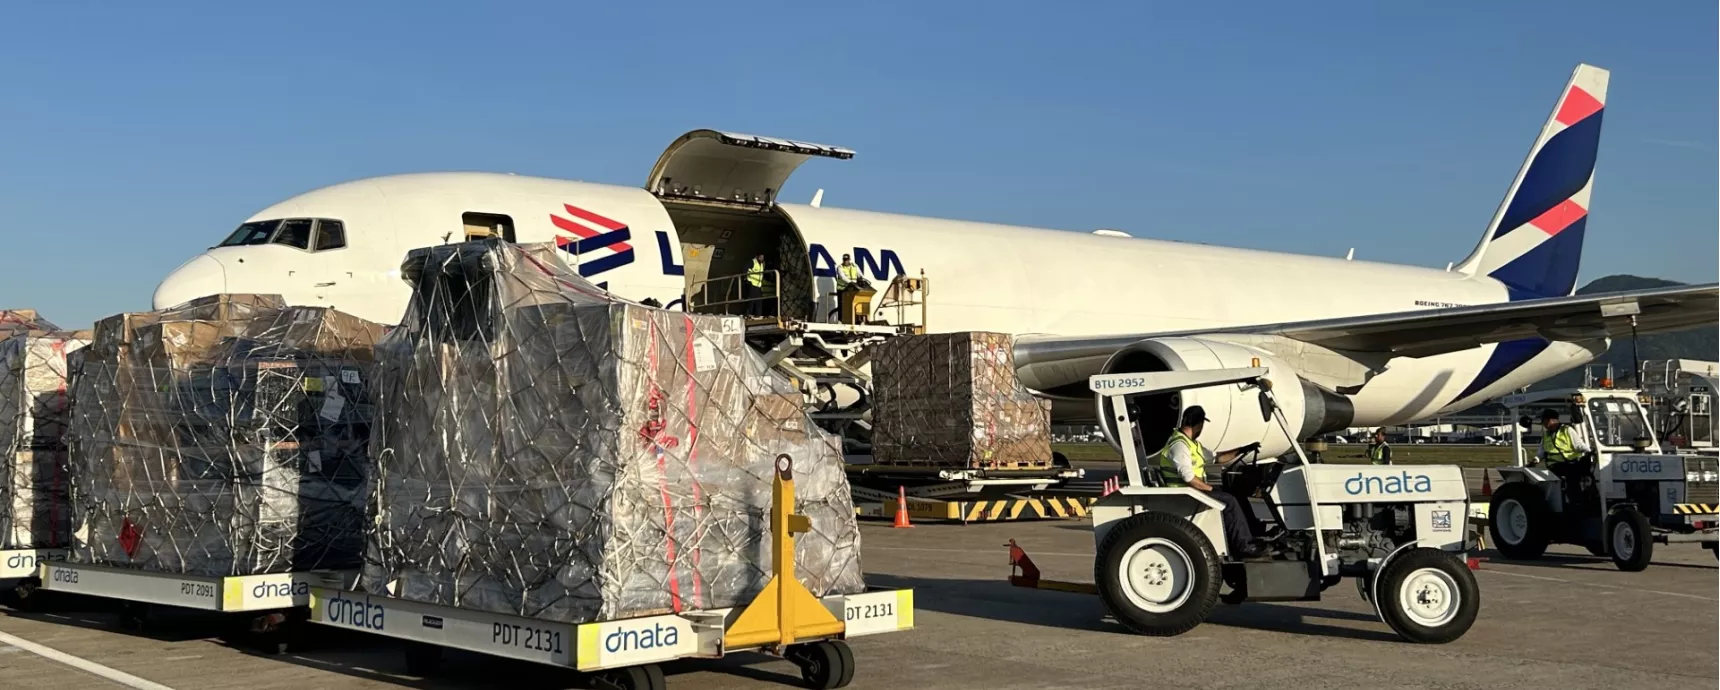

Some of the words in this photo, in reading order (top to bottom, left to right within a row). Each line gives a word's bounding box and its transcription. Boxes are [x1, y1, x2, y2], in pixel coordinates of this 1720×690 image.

[1095, 380, 1115, 389] BTU
[1118, 378, 1145, 388] 2952
[1621, 456, 1662, 473] dnata
[1345, 470, 1431, 495] dnata
[54, 569, 79, 584] dnata
[181, 582, 194, 595] PDT
[196, 583, 214, 597] 2091
[253, 581, 309, 598] dnata
[328, 592, 385, 630] dnata
[864, 603, 893, 618] 2131
[492, 622, 521, 646] PDT
[524, 627, 563, 654] 2131
[605, 622, 678, 653] dnata
